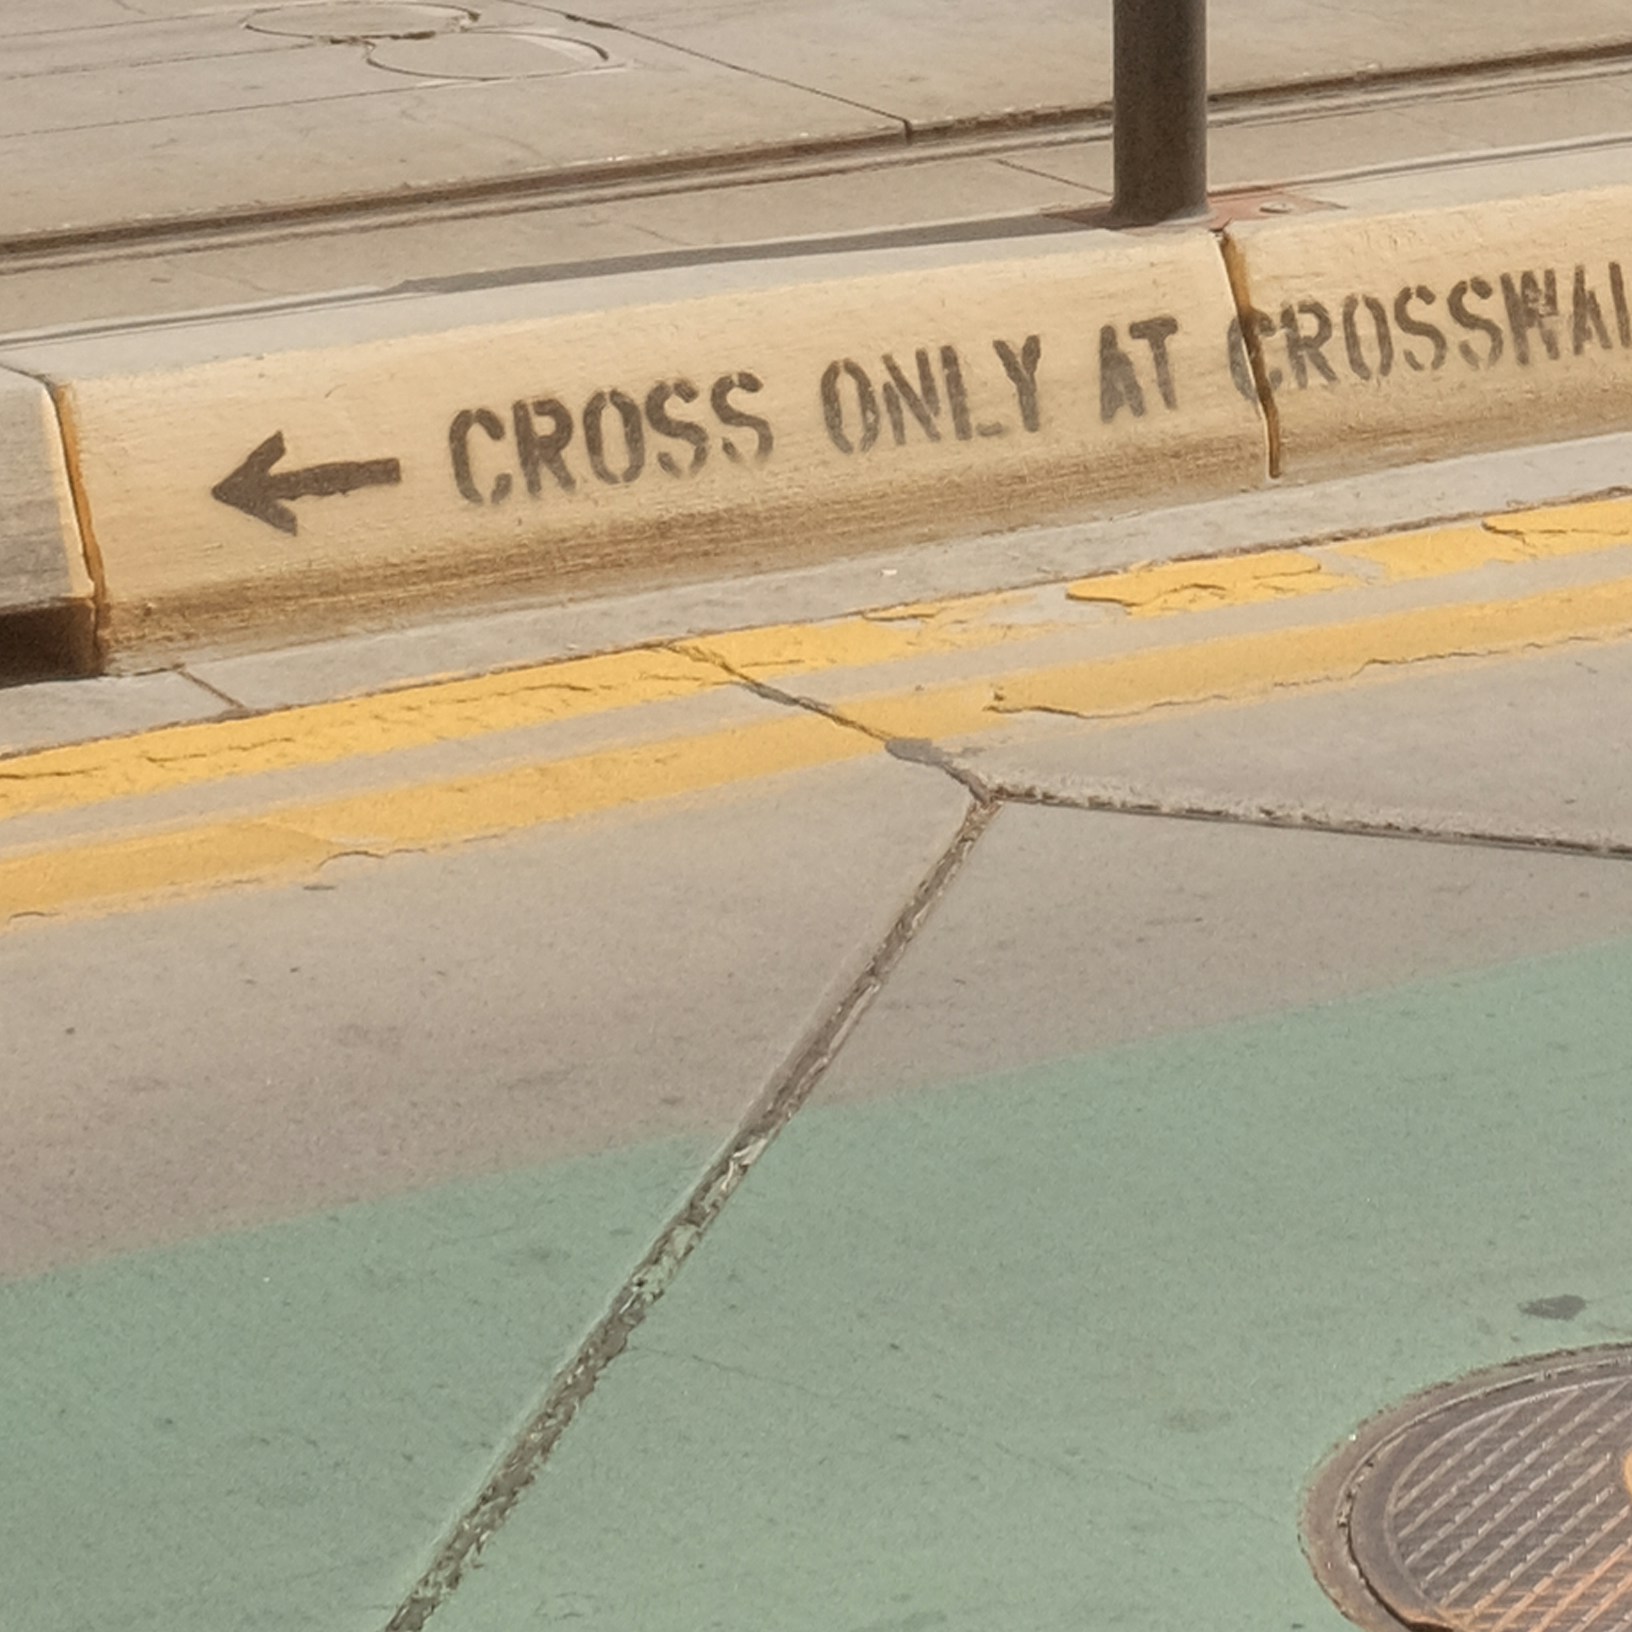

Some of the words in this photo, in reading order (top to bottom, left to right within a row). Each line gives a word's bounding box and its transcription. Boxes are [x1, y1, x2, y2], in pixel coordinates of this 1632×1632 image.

[447, 371, 774, 506] CROSS
[819, 334, 1042, 455] ONLY
[1098, 314, 1179, 424] AT
